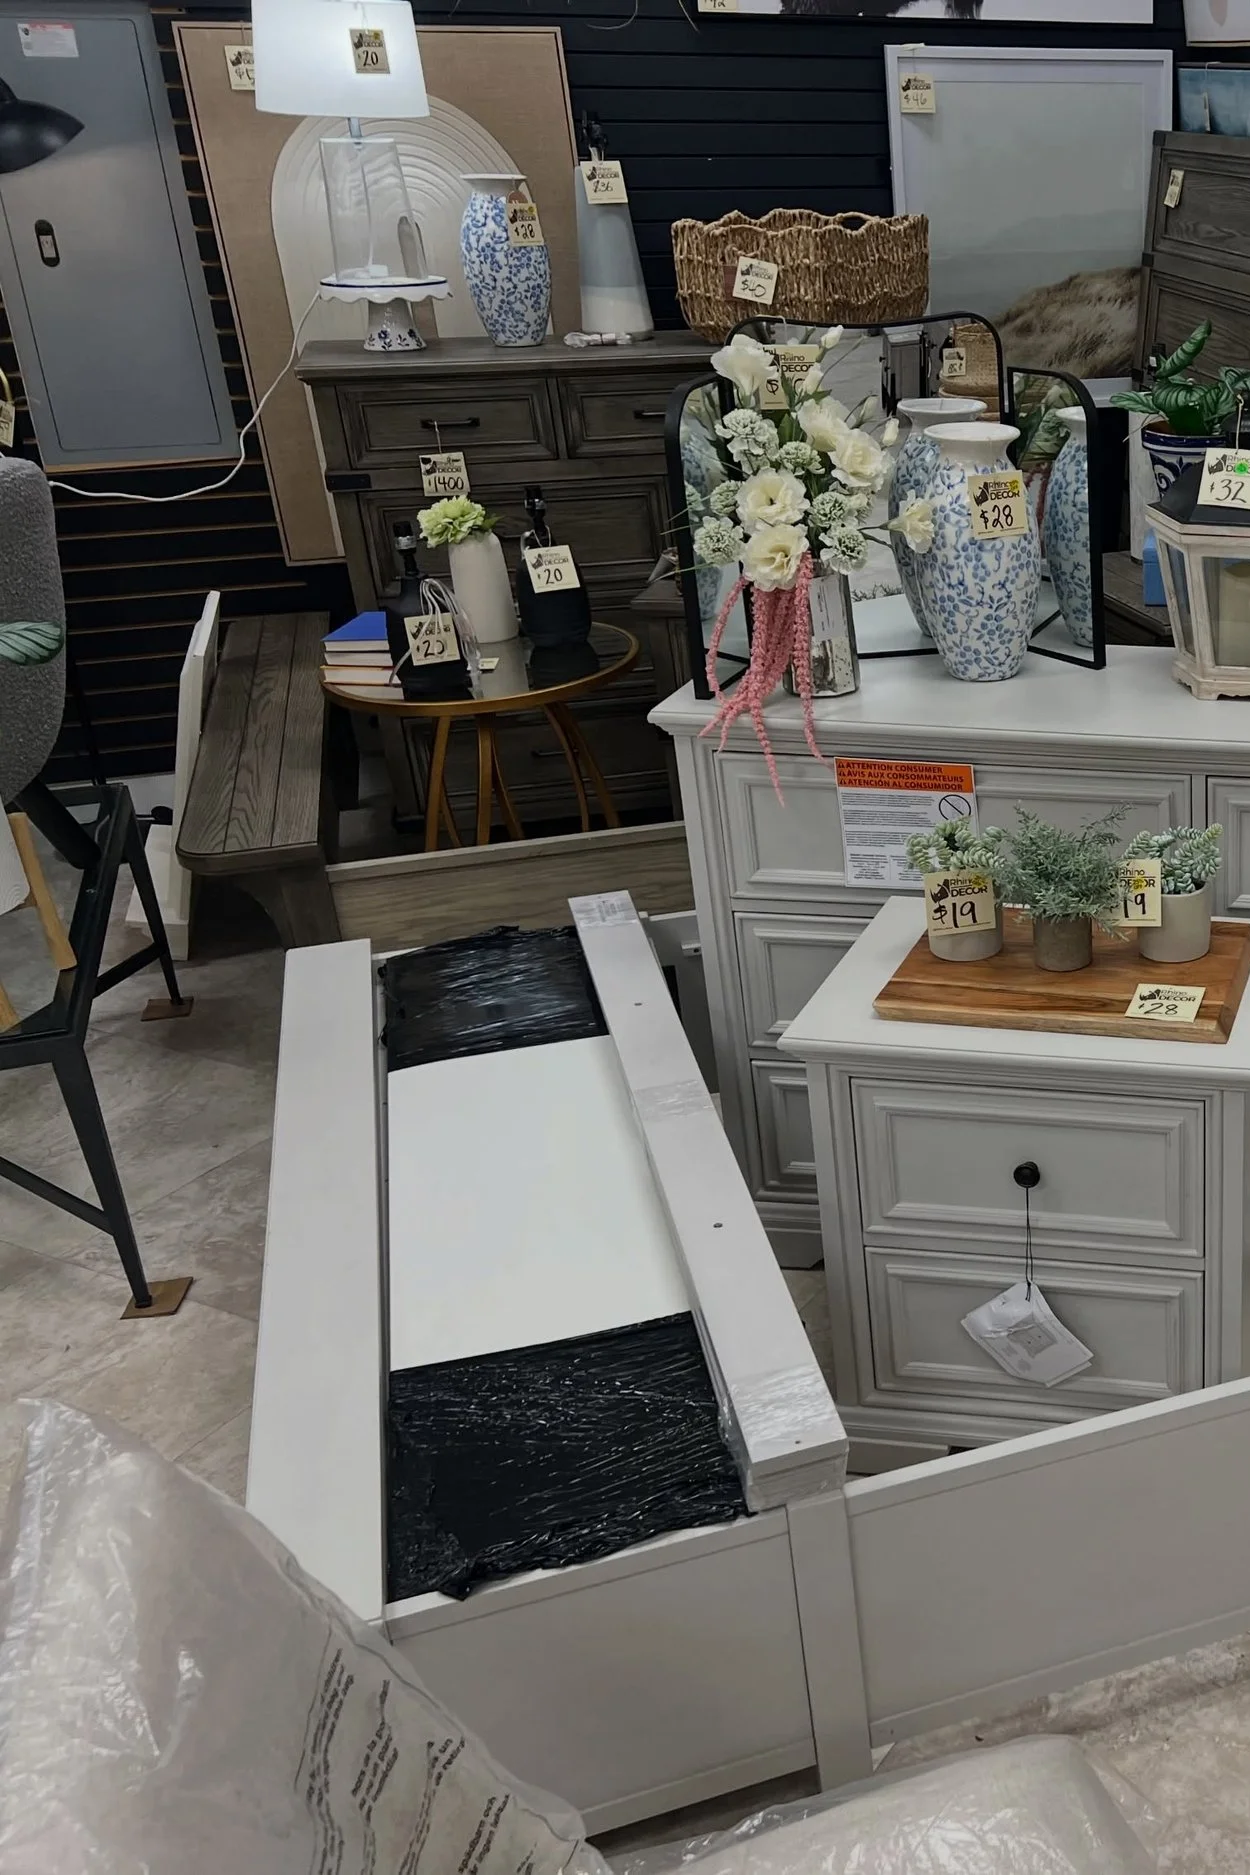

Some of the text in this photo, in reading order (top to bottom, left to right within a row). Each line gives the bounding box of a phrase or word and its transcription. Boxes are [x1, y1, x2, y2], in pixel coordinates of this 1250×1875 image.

[989, 490, 1020, 501] DECOR
[1209, 478, 1247, 504] $32
[979, 504, 1014, 530] $28
[845, 762, 943, 774] ATTENTION CONSUMER
[847, 770, 866, 778] AVIS
[886, 773, 964, 783] CONSOMMATEURS
[904, 781, 963, 791] CONSUMIDOR
[950, 885, 988, 897] DECOR
[932, 900, 977, 928] $19
[1138, 1002, 1178, 1015] $28
